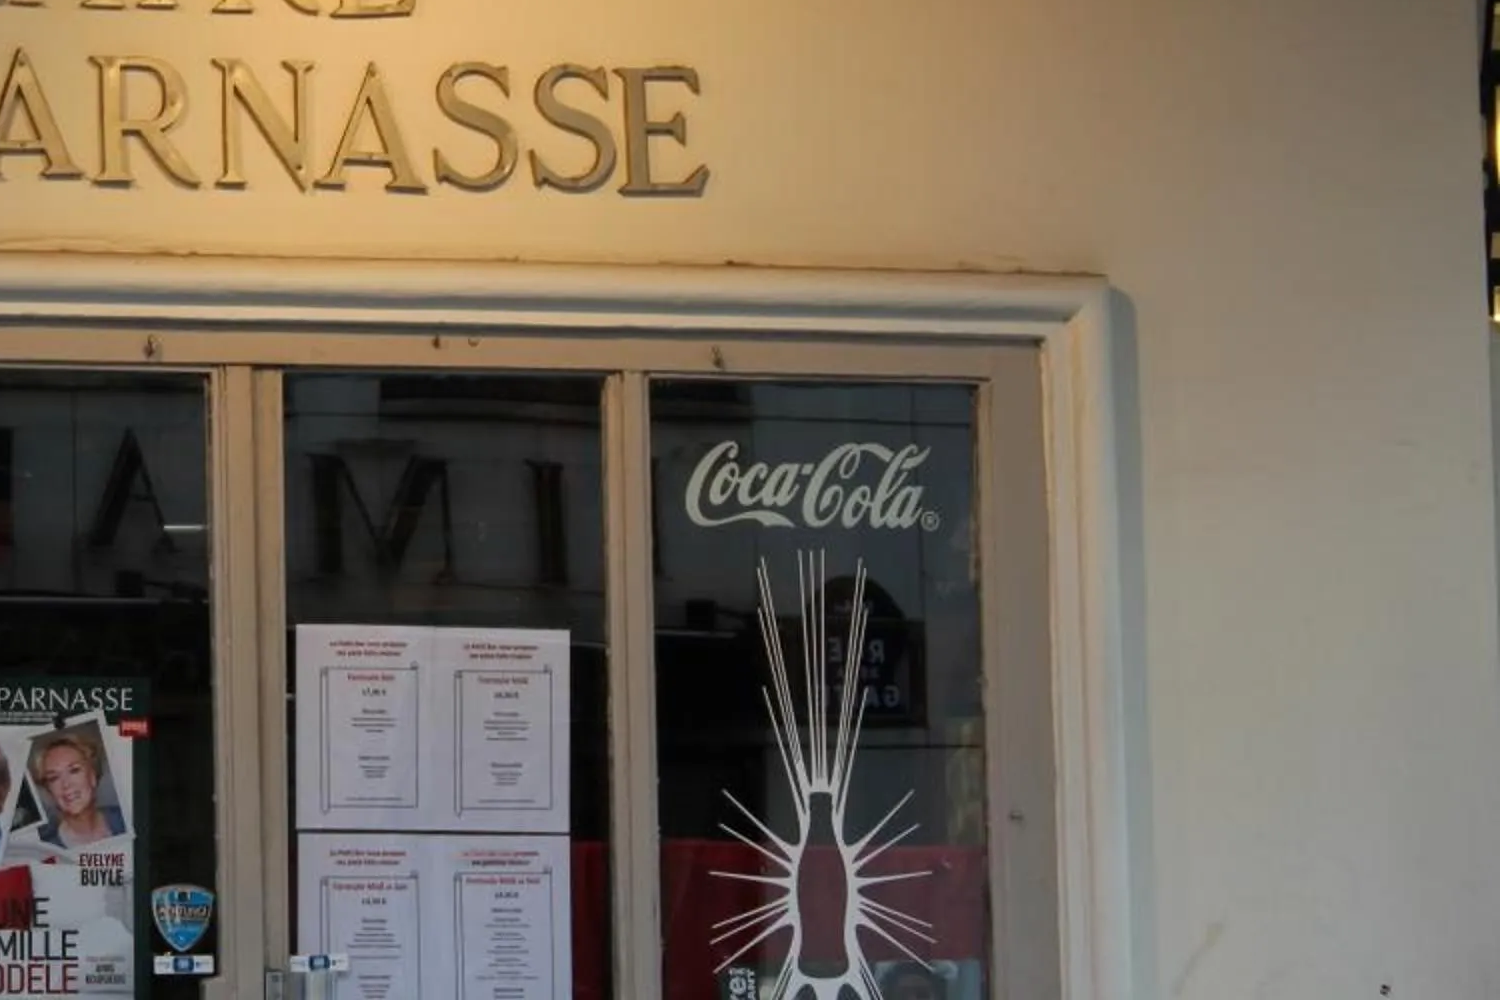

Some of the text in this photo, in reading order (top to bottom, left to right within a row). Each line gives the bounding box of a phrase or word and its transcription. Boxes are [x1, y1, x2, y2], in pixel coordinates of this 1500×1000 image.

[685, 440, 932, 529] Coca-Cola
[79, 853, 125, 867] EVELYNE
[81, 869, 124, 887] BUYLE
